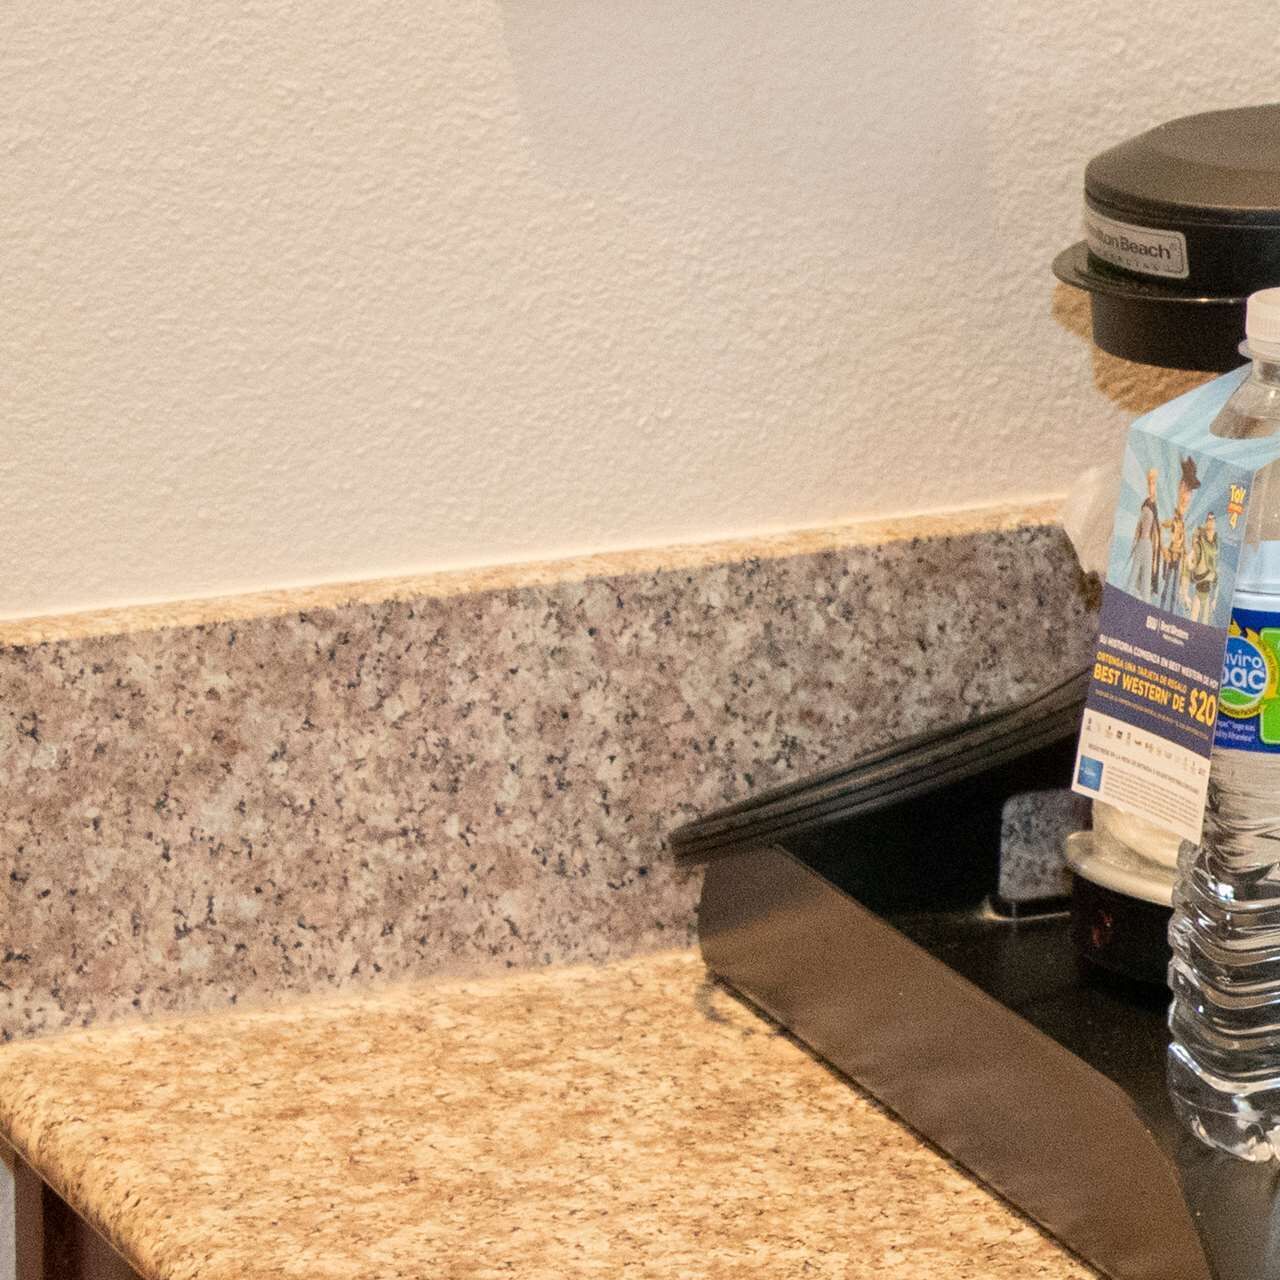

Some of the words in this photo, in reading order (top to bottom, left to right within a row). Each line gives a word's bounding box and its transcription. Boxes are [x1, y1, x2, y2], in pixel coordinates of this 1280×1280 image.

[1120, 236, 1171, 260] Beach
[1093, 663, 1121, 686] BEST
[1122, 673, 1169, 705] WESTERN
[1172, 694, 1185, 713] DE
[1189, 687, 1218, 727] $20
